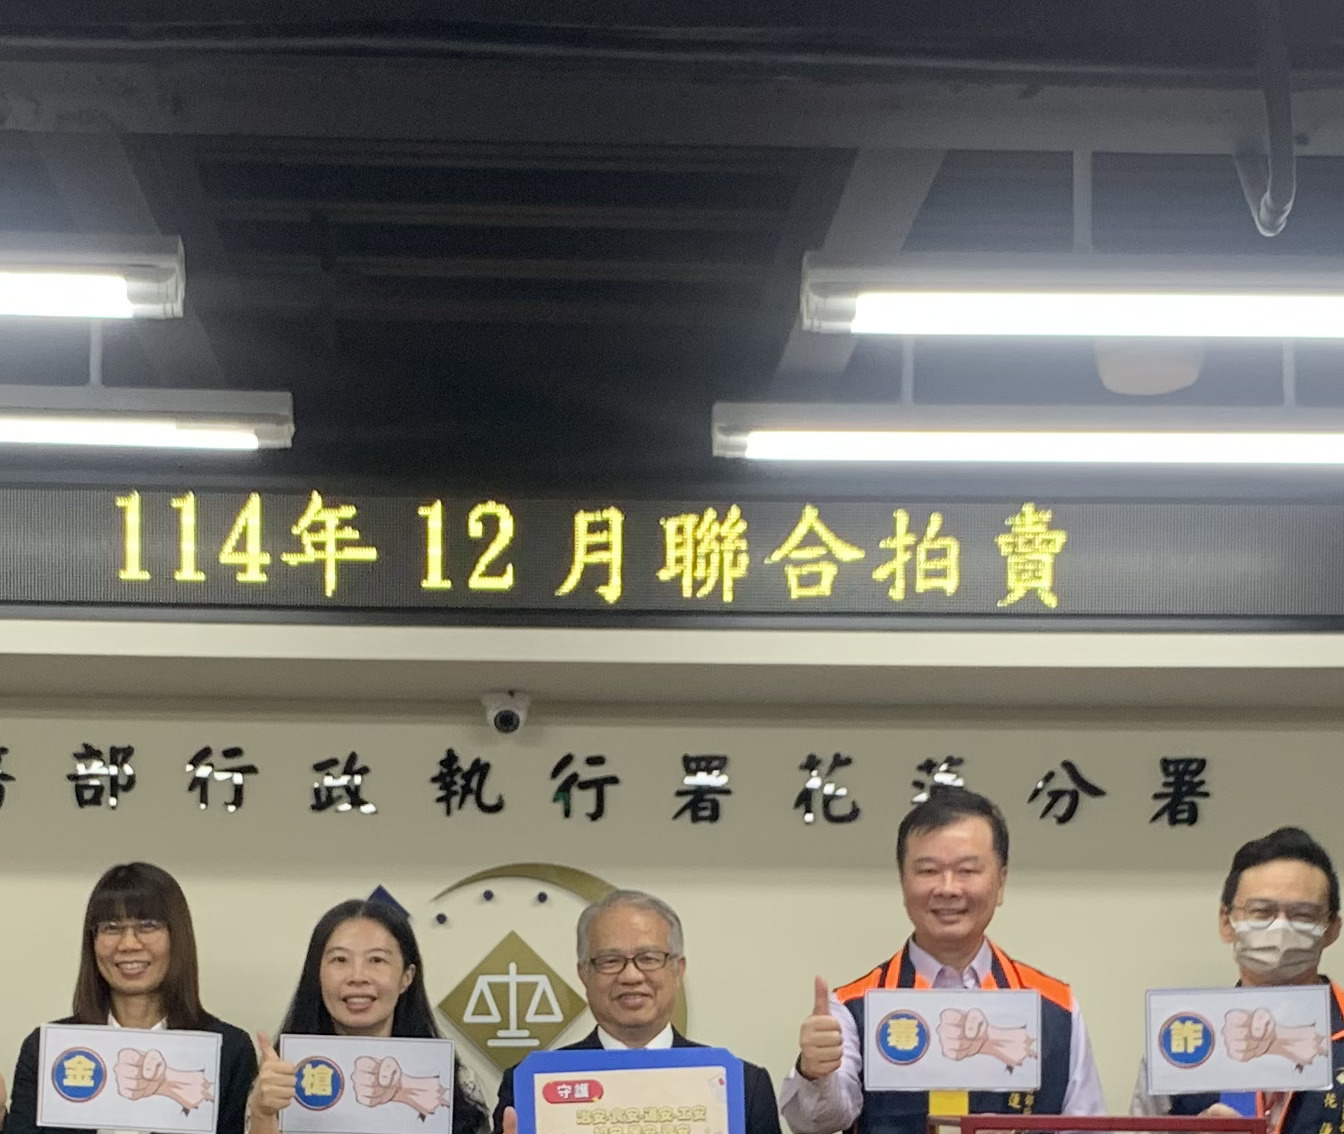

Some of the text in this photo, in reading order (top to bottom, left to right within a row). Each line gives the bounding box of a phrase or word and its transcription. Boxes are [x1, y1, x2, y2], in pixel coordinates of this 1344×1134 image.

[1170, 1021, 1204, 1054] 詐
[62, 1054, 96, 1088] 金
[556, 1082, 591, 1100] 守護
